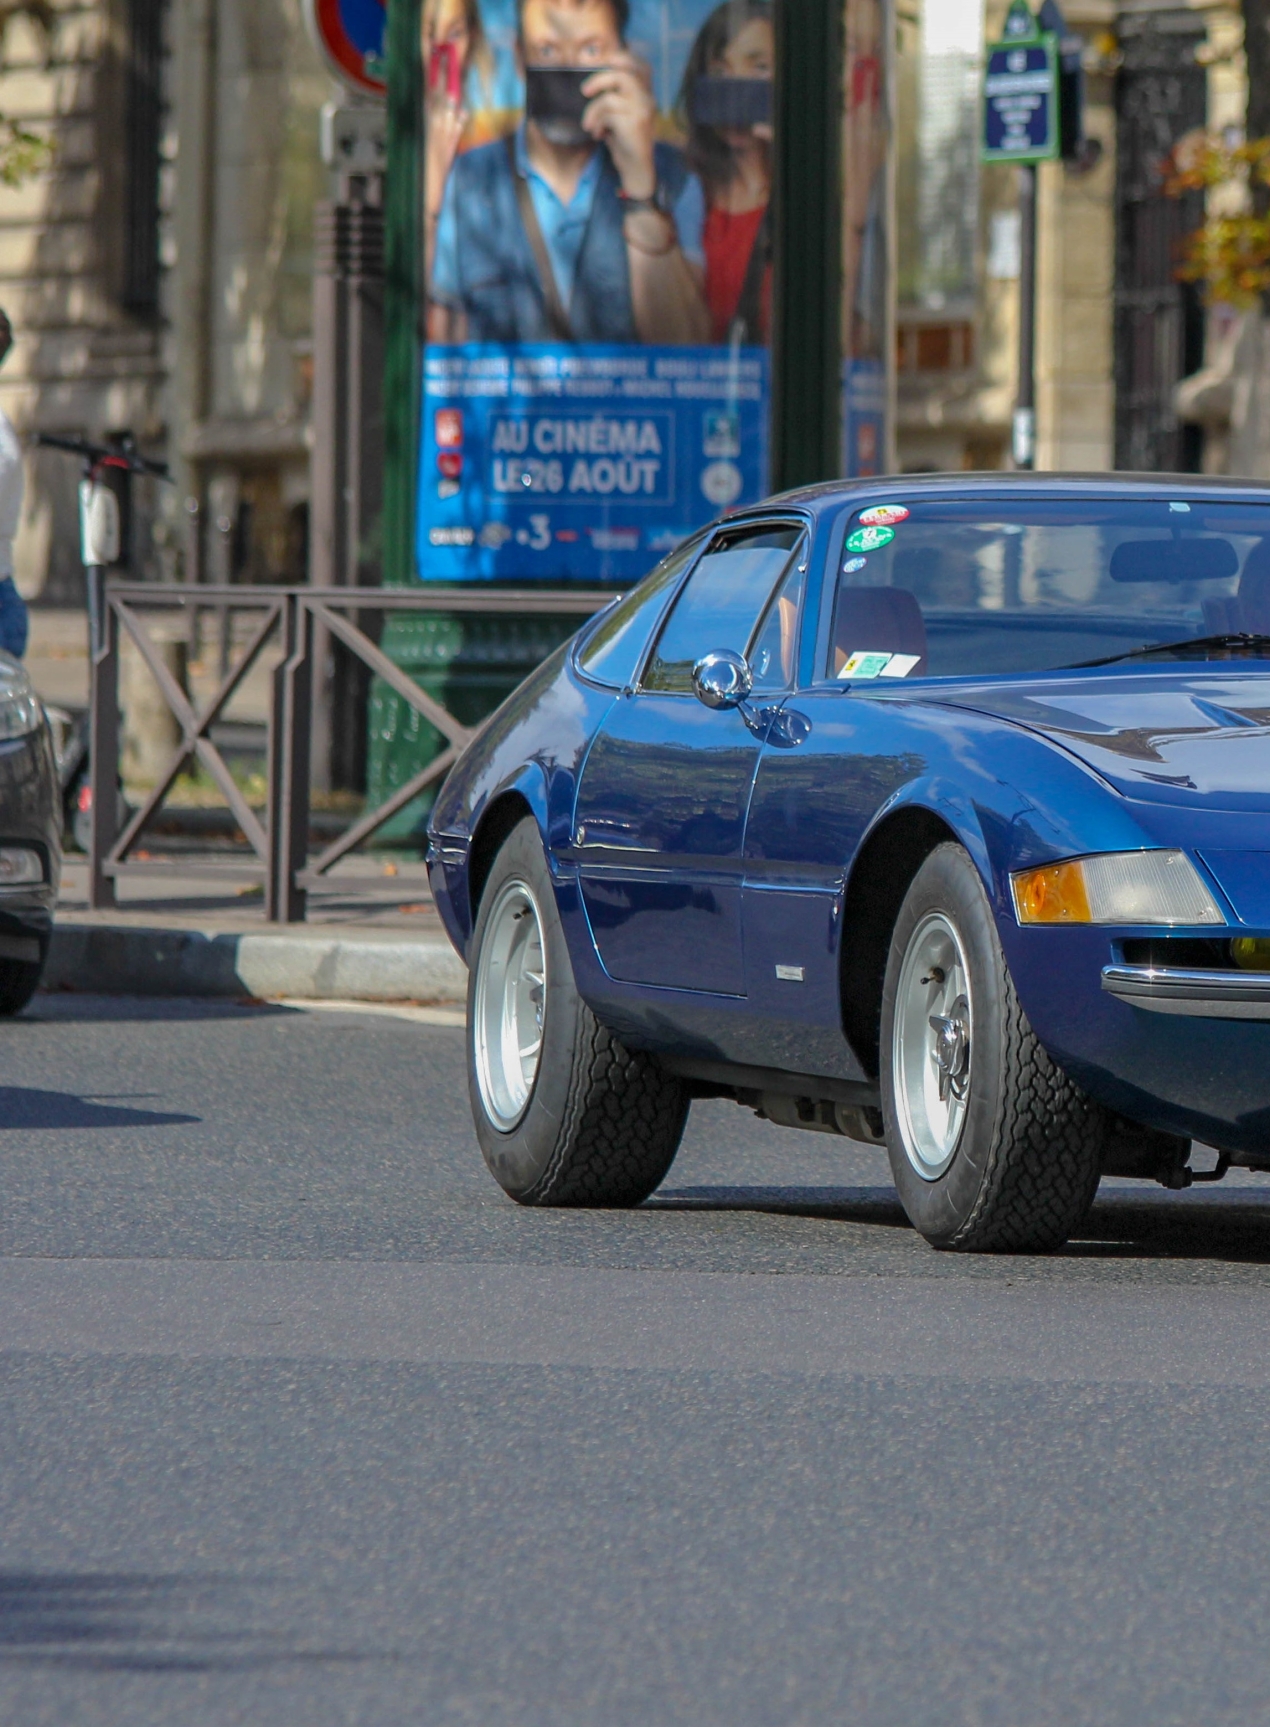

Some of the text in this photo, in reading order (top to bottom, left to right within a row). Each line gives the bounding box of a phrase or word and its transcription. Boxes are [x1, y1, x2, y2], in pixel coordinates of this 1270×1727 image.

[493, 421, 528, 452] AU
[534, 415, 660, 454] CINÉMA
[494, 459, 522, 492] LE
[525, 458, 563, 493] 26
[569, 456, 660, 493] AOÛT
